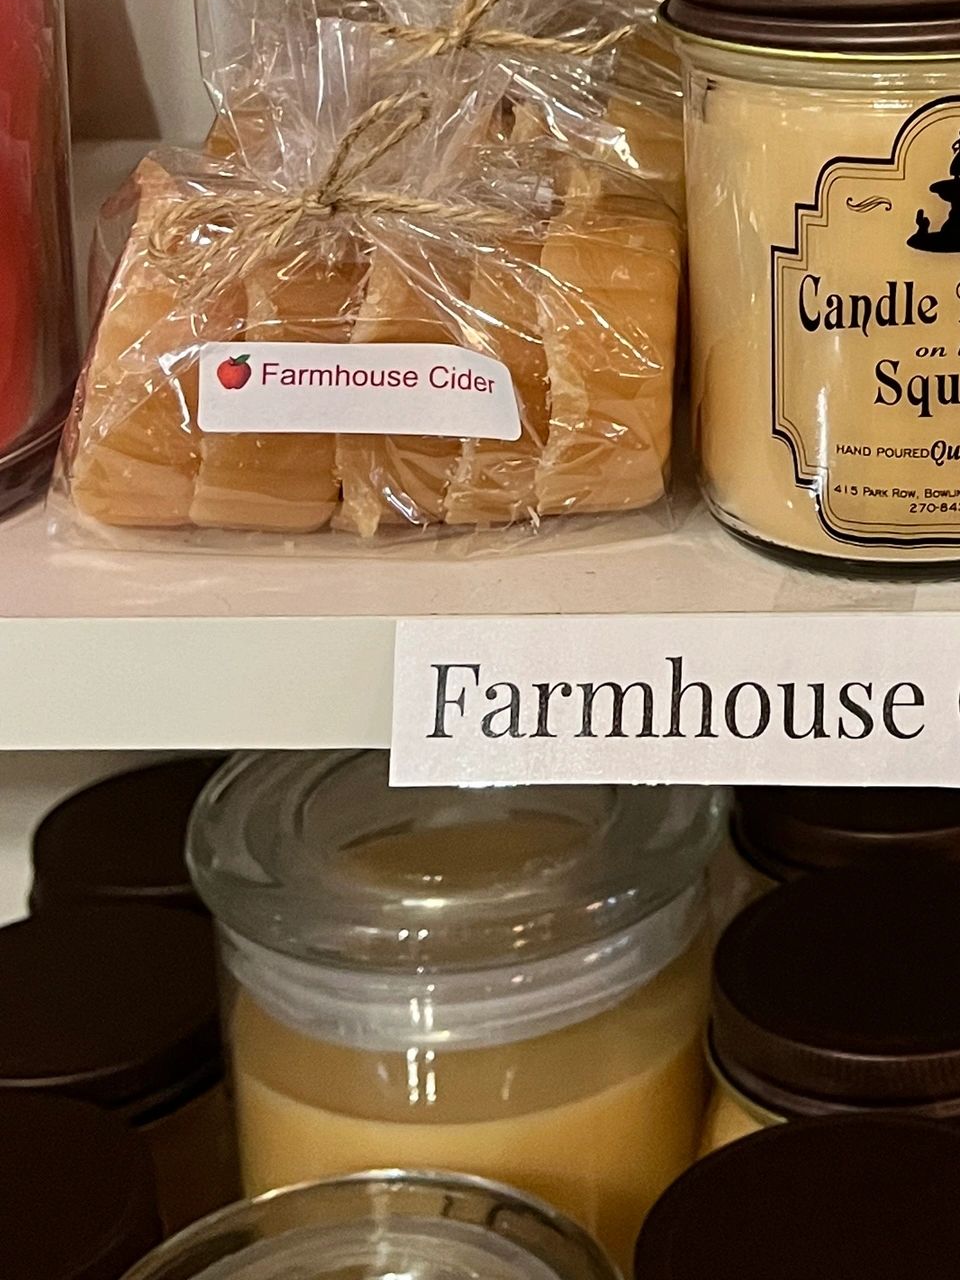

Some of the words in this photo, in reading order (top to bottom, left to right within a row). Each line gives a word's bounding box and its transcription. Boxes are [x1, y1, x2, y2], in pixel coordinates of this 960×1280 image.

[799, 274, 938, 337] Candle
[915, 344, 948, 358] on
[261, 363, 419, 389] Farmhouse
[429, 366, 496, 394] Cider
[836, 444, 872, 457] HAND
[876, 447, 930, 459] POURED
[834, 485, 859, 496] 415
[425, 657, 926, 741] Farmhouse
